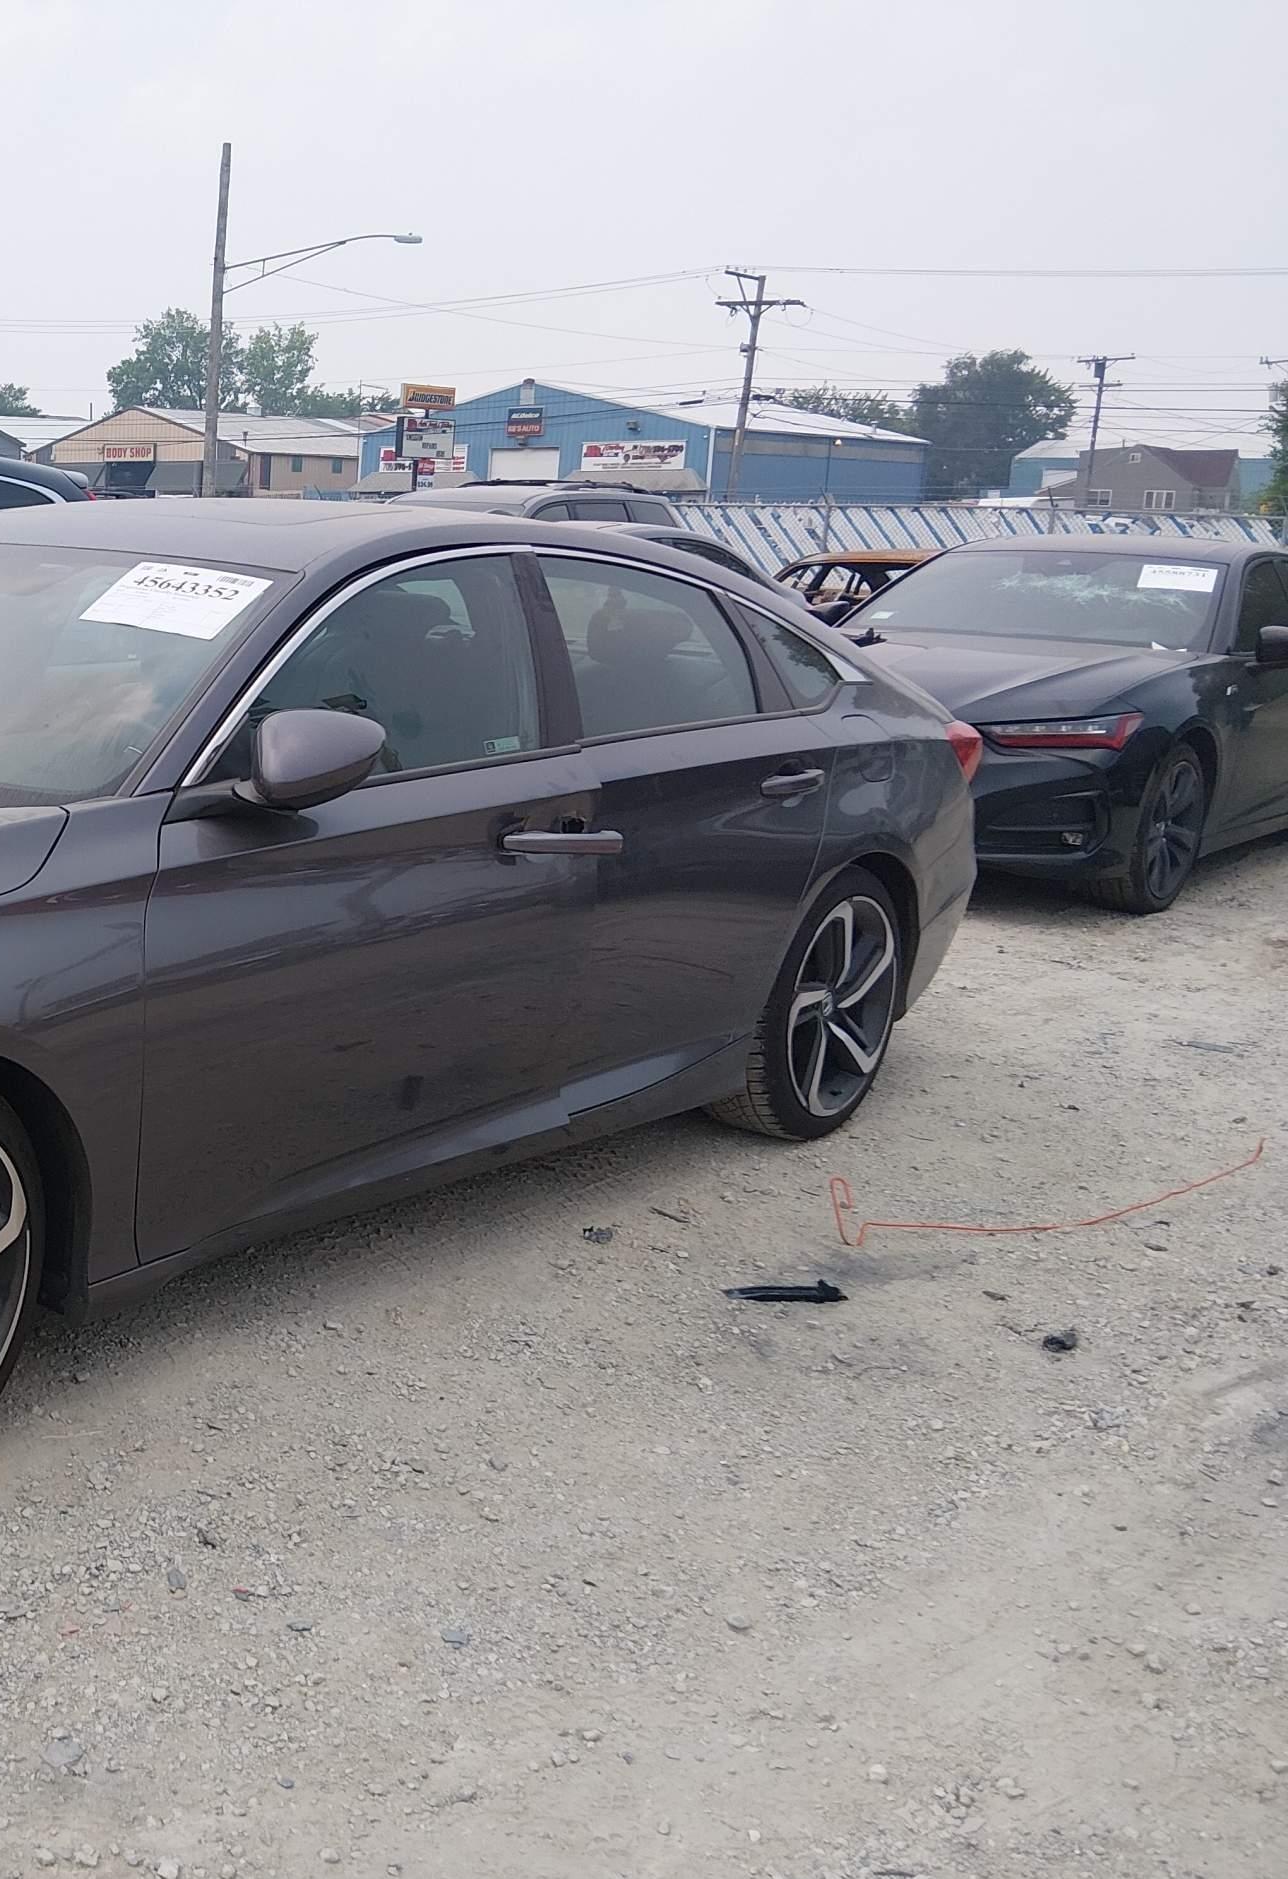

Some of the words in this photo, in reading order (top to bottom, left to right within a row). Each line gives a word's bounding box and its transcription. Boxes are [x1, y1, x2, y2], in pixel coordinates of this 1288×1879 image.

[106, 447, 127, 458] BODY
[129, 446, 152, 458] SHOP
[133, 575, 240, 601] 45643352
